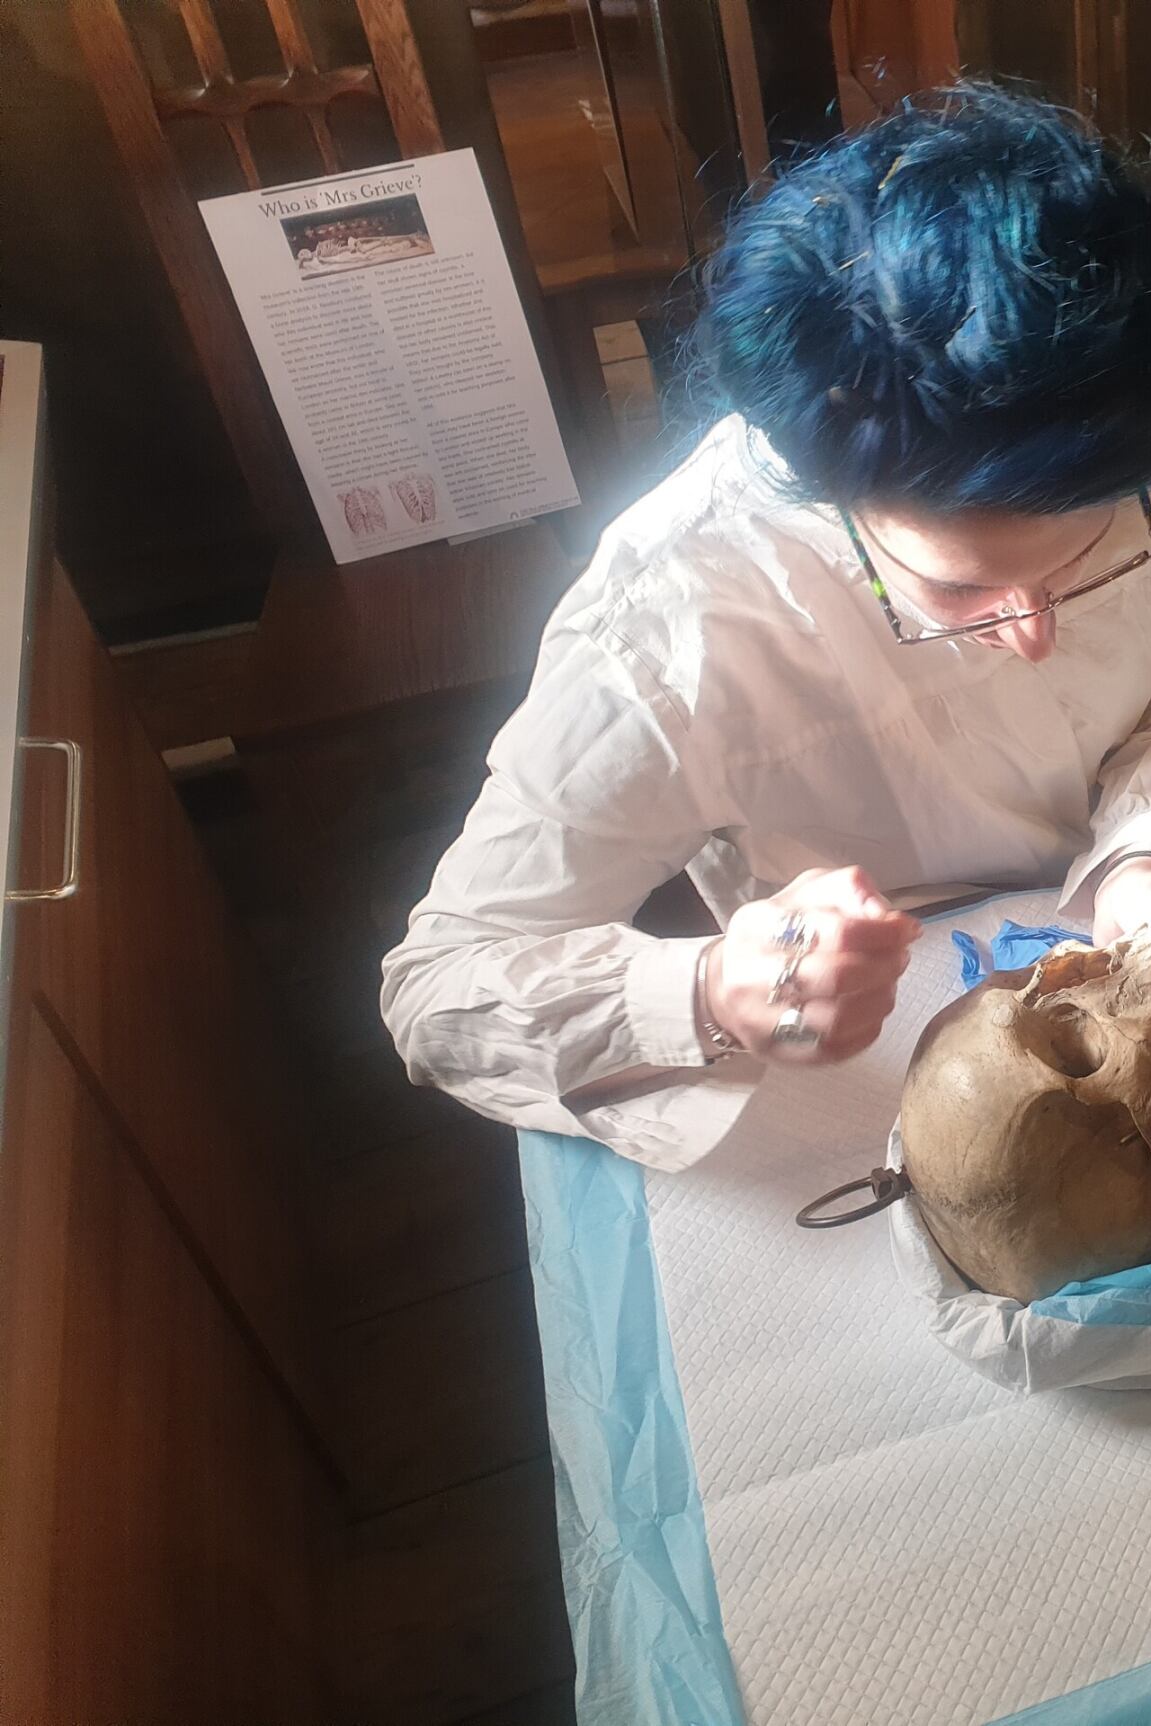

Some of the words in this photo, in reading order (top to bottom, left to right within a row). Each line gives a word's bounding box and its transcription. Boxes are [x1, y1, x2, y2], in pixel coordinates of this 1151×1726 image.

[258, 200, 300, 218] Who
[304, 195, 318, 210] is
[360, 174, 422, 199] Grieve'?
